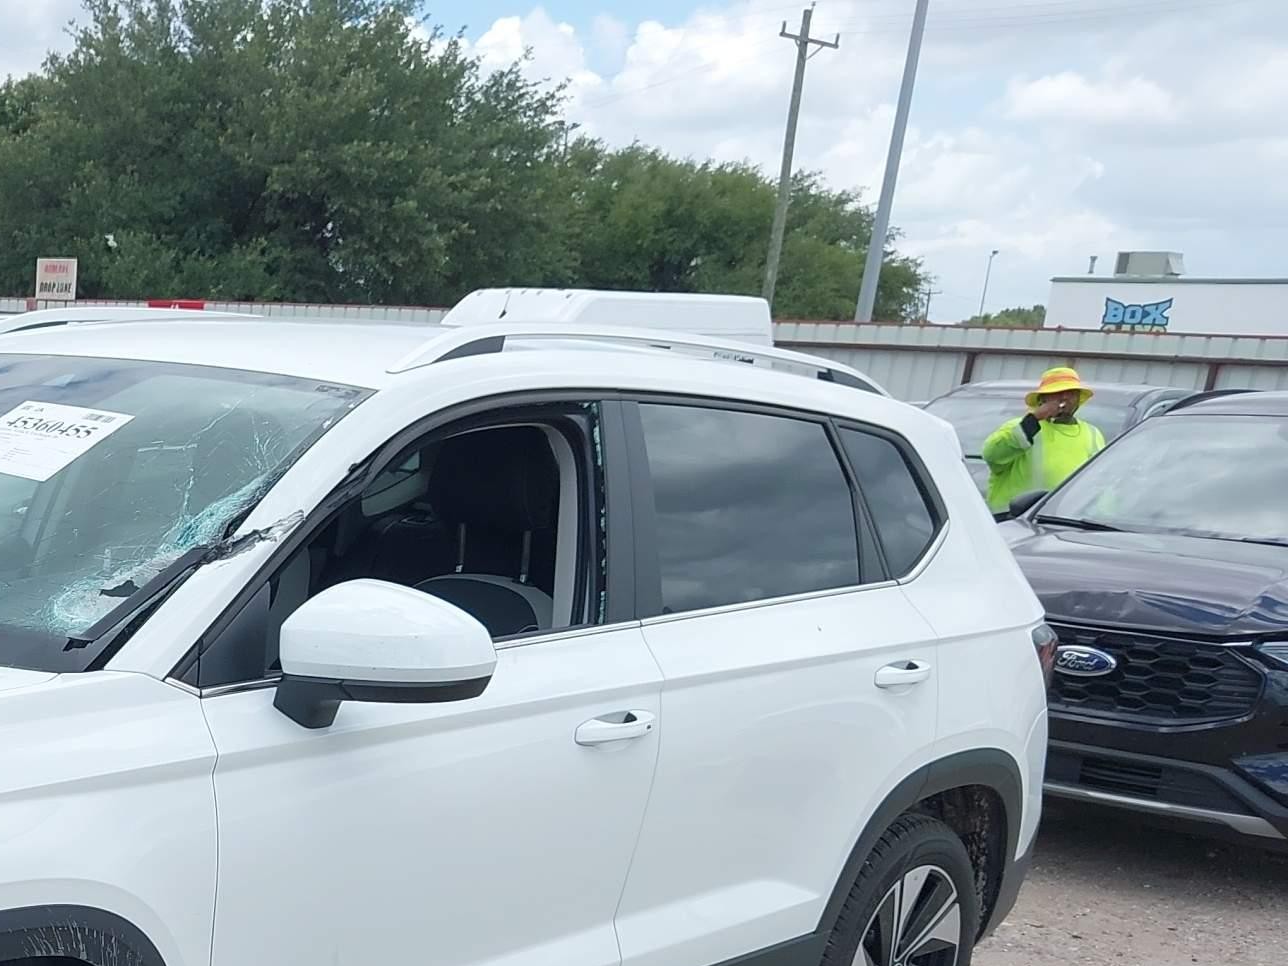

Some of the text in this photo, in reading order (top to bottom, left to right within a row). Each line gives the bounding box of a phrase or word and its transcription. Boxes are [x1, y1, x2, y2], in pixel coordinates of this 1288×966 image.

[1102, 296, 1174, 326] BOX
[7, 415, 99, 438] 45360455
[1057, 650, 1099, 671] Ford
